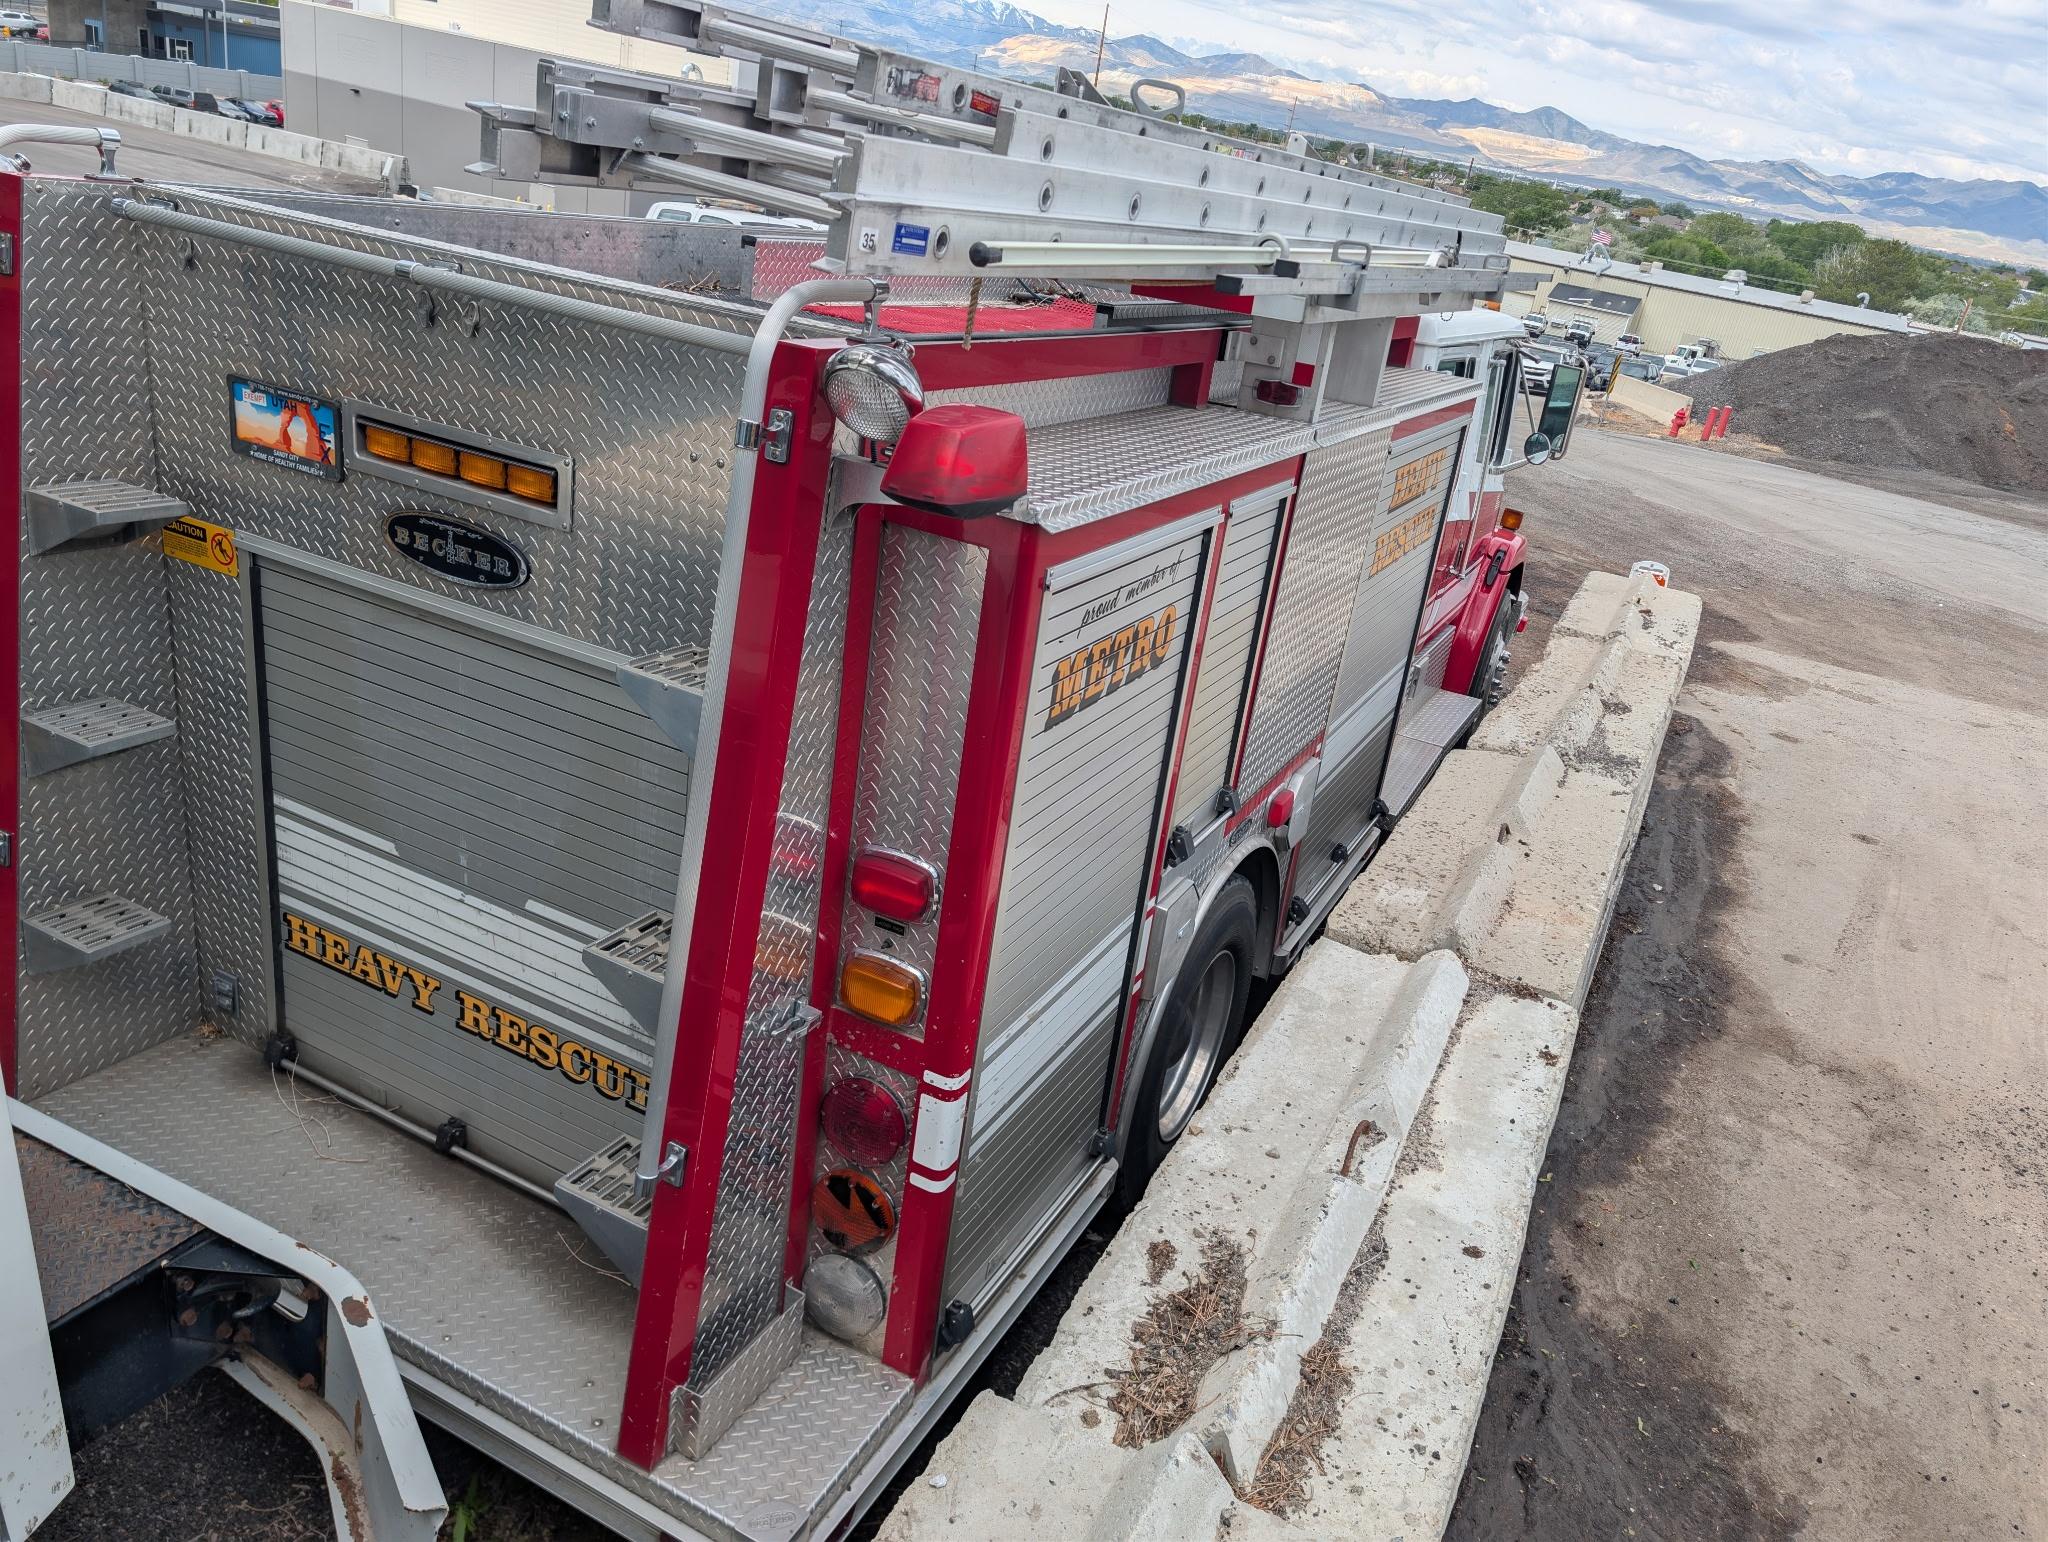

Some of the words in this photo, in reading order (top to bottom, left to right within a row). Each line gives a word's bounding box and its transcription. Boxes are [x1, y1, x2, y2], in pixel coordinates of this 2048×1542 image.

[862, 232, 876, 249] 35
[243, 390, 266, 405] EXEMPT
[271, 396, 298, 413] UTAH
[254, 451, 268, 461] HOME
[275, 457, 296, 469] HEALTHY
[273, 449, 289, 459] SANDY
[288, 453, 300, 462] CITY
[394, 525, 512, 577] BECKER
[1369, 502, 1438, 579] RESCUE
[1076, 586, 1123, 640] proud
[1124, 564, 1166, 603] member
[1166, 549, 1185, 585] of
[1047, 604, 1177, 730] METRO
[283, 912, 442, 1016] HEAVY
